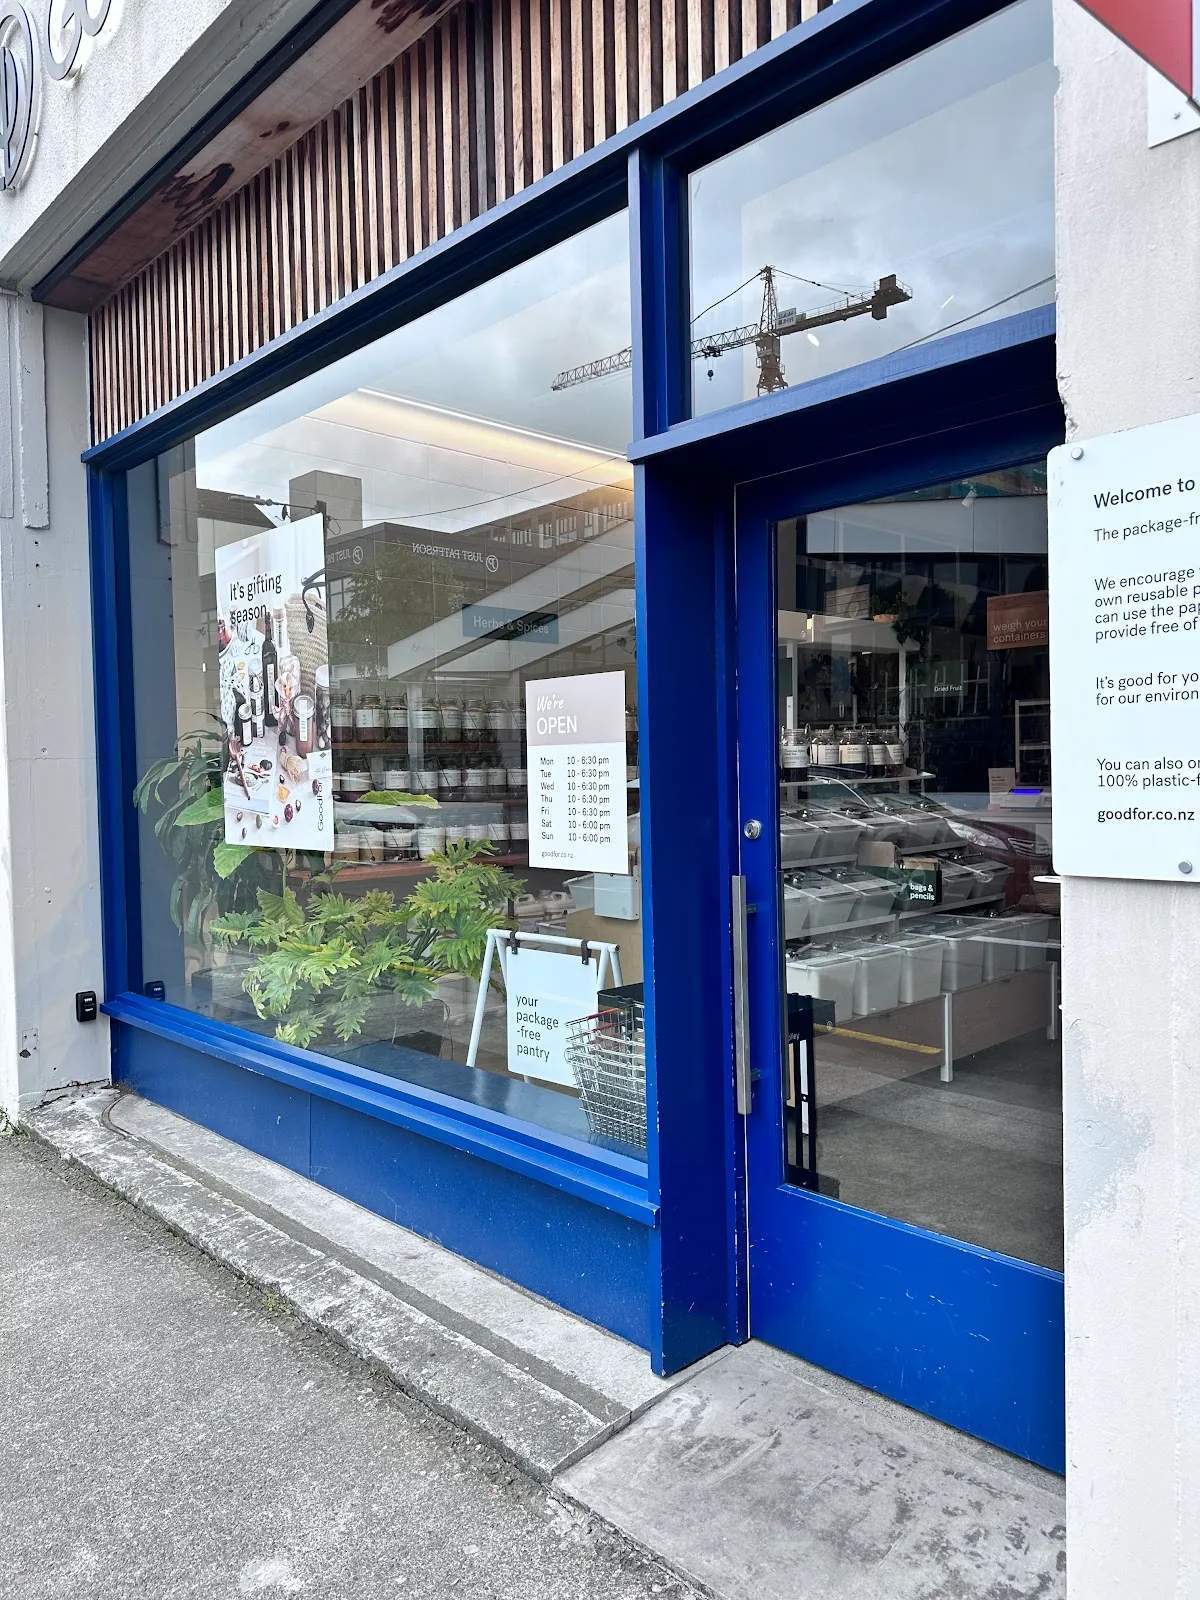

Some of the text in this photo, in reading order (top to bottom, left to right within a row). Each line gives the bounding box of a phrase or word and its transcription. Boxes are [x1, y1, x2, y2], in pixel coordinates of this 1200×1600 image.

[1093, 478, 1195, 508] Welcome to
[1093, 528, 1119, 542] The
[1094, 568, 1195, 591] We encourage
[230, 573, 282, 602] It's gifting
[1095, 595, 1122, 608] own
[1127, 584, 1188, 604] reusable
[230, 604, 267, 625] season
[1095, 612, 1118, 624] can
[1123, 609, 1147, 621] use
[1151, 603, 1174, 617] the
[473, 615, 550, 634] Herbs & Spices
[993, 619, 1022, 632] weigh
[1095, 616, 1199, 644] provide free of
[993, 631, 1047, 643] containers
[1096, 671, 1199, 691] It's good for yo
[536, 694, 564, 712] We're
[1096, 688, 1199, 706] for our environ
[536, 715, 577, 735] OPEN
[540, 757, 554, 765] Mon
[567, 756, 576, 765] 10
[581, 755, 597, 765] 6:30
[598, 757, 610, 767] pm
[1097, 758, 1121, 770] You
[1125, 760, 1149, 770] can
[1154, 756, 1183, 770] also
[540, 769, 552, 778] Tue
[567, 769, 576, 778] 10
[581, 768, 597, 778] 6:30
[598, 770, 610, 779] pm
[1098, 774, 1138, 787] 100%
[540, 780, 555, 790] Wed
[567, 782, 576, 791] 10
[581, 781, 598, 791] 6:30
[598, 783, 610, 792] pm
[540, 794, 553, 803] Thu
[568, 794, 577, 803] 10
[582, 794, 598, 804] 6:30
[599, 797, 611, 806] pm
[540, 806, 550, 815] Fri
[568, 807, 577, 816] 10
[582, 807, 598, 817] 6:30
[599, 810, 611, 819] pm
[1097, 807, 1195, 823] goodfor.co.nz
[541, 819, 552, 828] Sat
[568, 820, 577, 829] 10
[582, 820, 598, 830] 6:00
[600, 823, 611, 832] pm
[541, 831, 554, 840] Sun
[568, 833, 577, 842] 10
[582, 833, 599, 843] 6:00
[600, 836, 611, 845] pm
[910, 883, 934, 892] bags &
[516, 994, 539, 1007] your
[516, 1012, 559, 1030] package
[517, 1026, 541, 1040] -free
[516, 1045, 550, 1062] pantry
